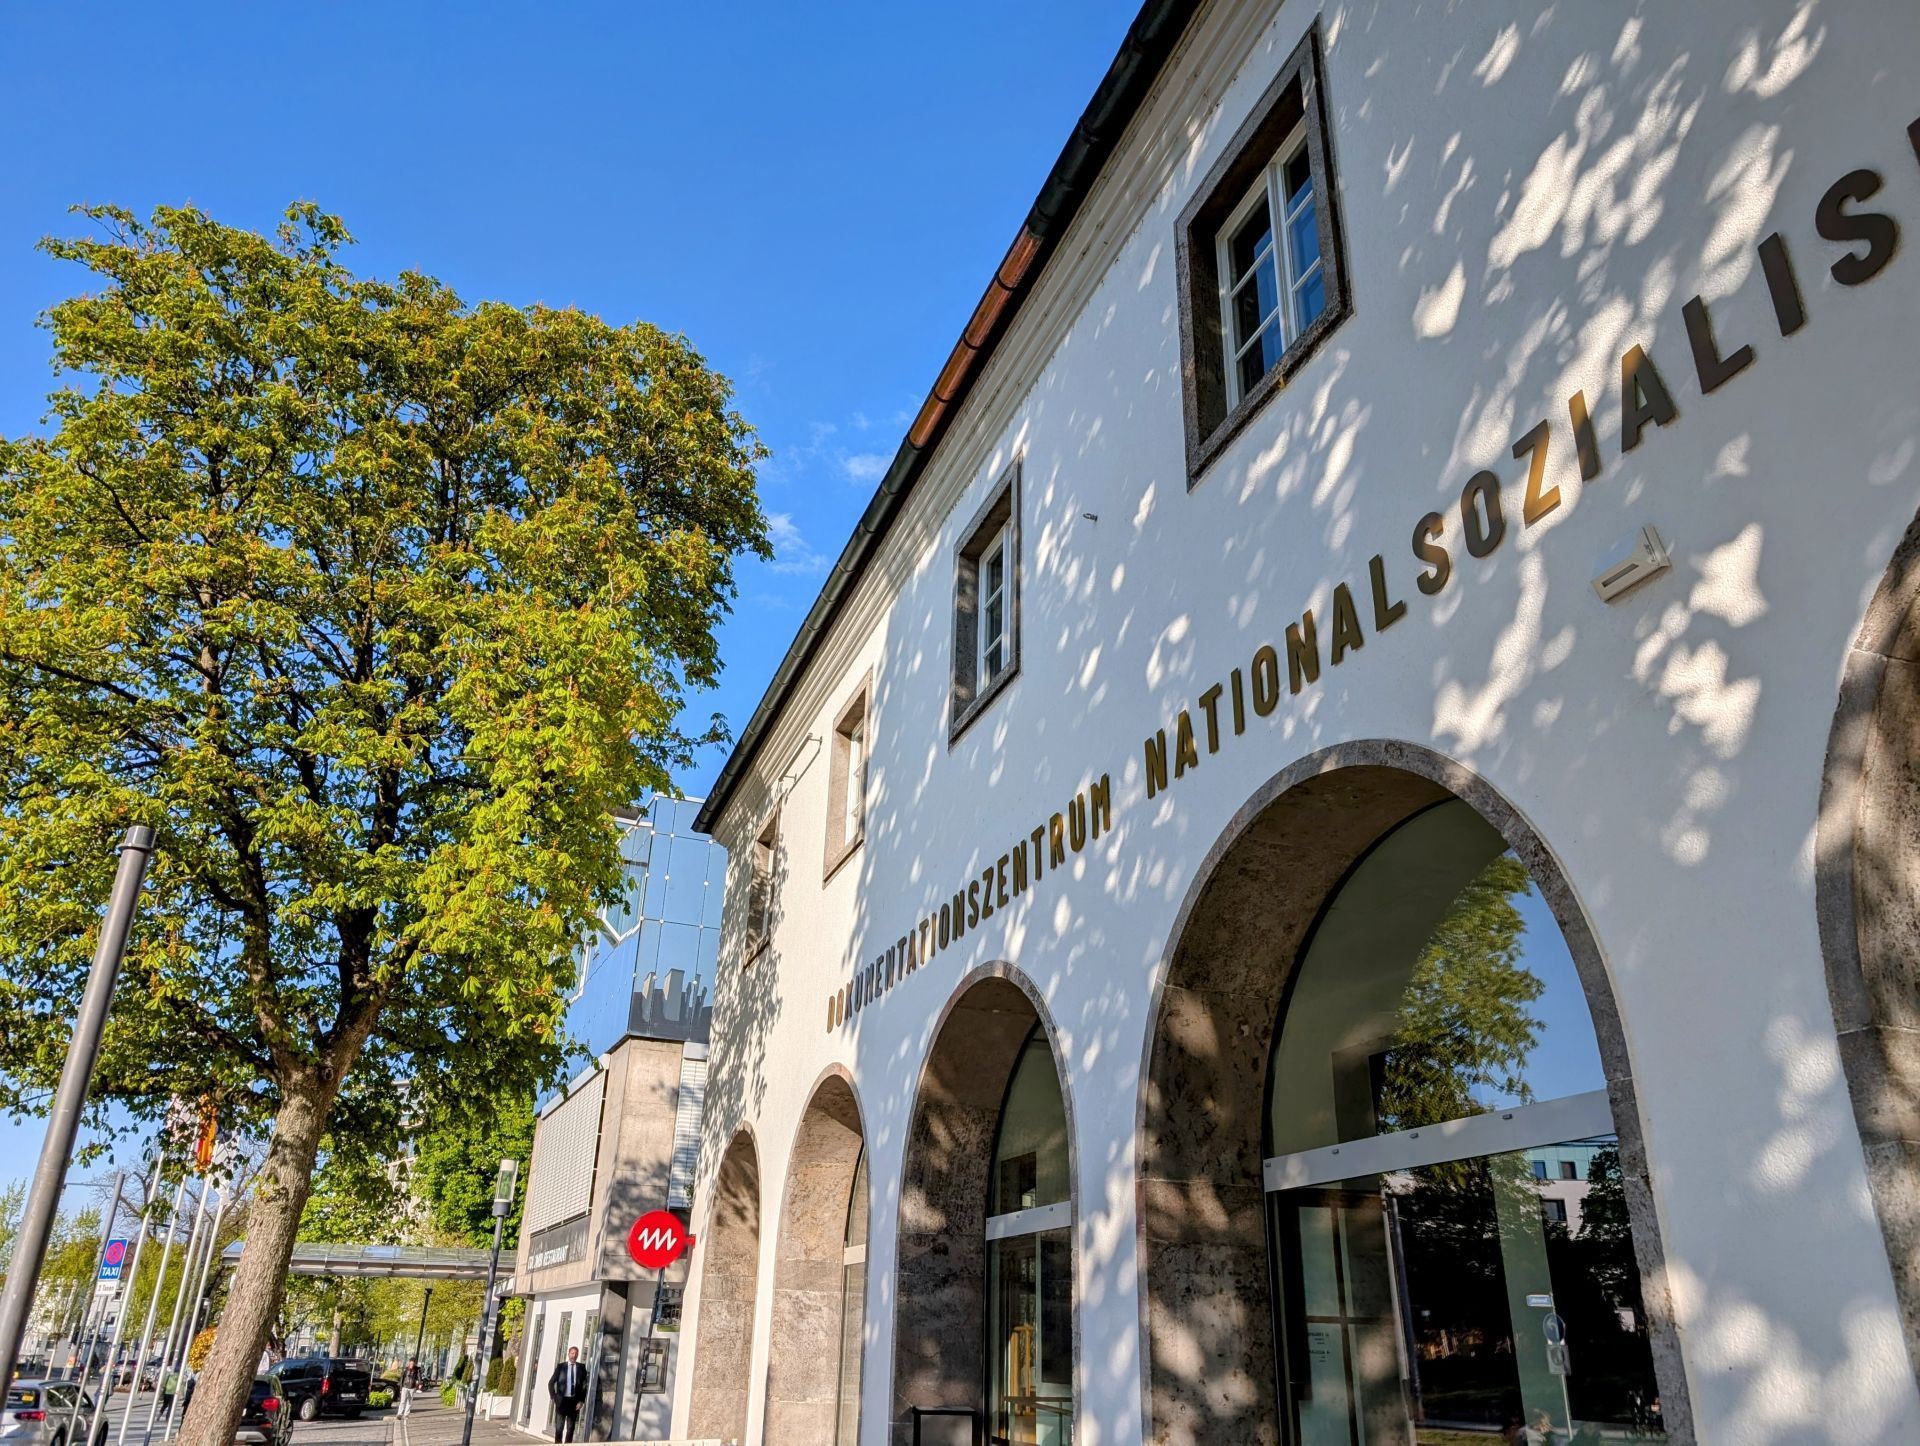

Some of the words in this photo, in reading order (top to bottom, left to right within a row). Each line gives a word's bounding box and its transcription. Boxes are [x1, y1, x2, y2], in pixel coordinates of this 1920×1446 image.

[827, 773, 1111, 1033] DOKUMENTATIONSZENTRUM
[1144, 116, 1920, 799] NATIONALSOZIALIS
[102, 1267, 119, 1276] TAXI
